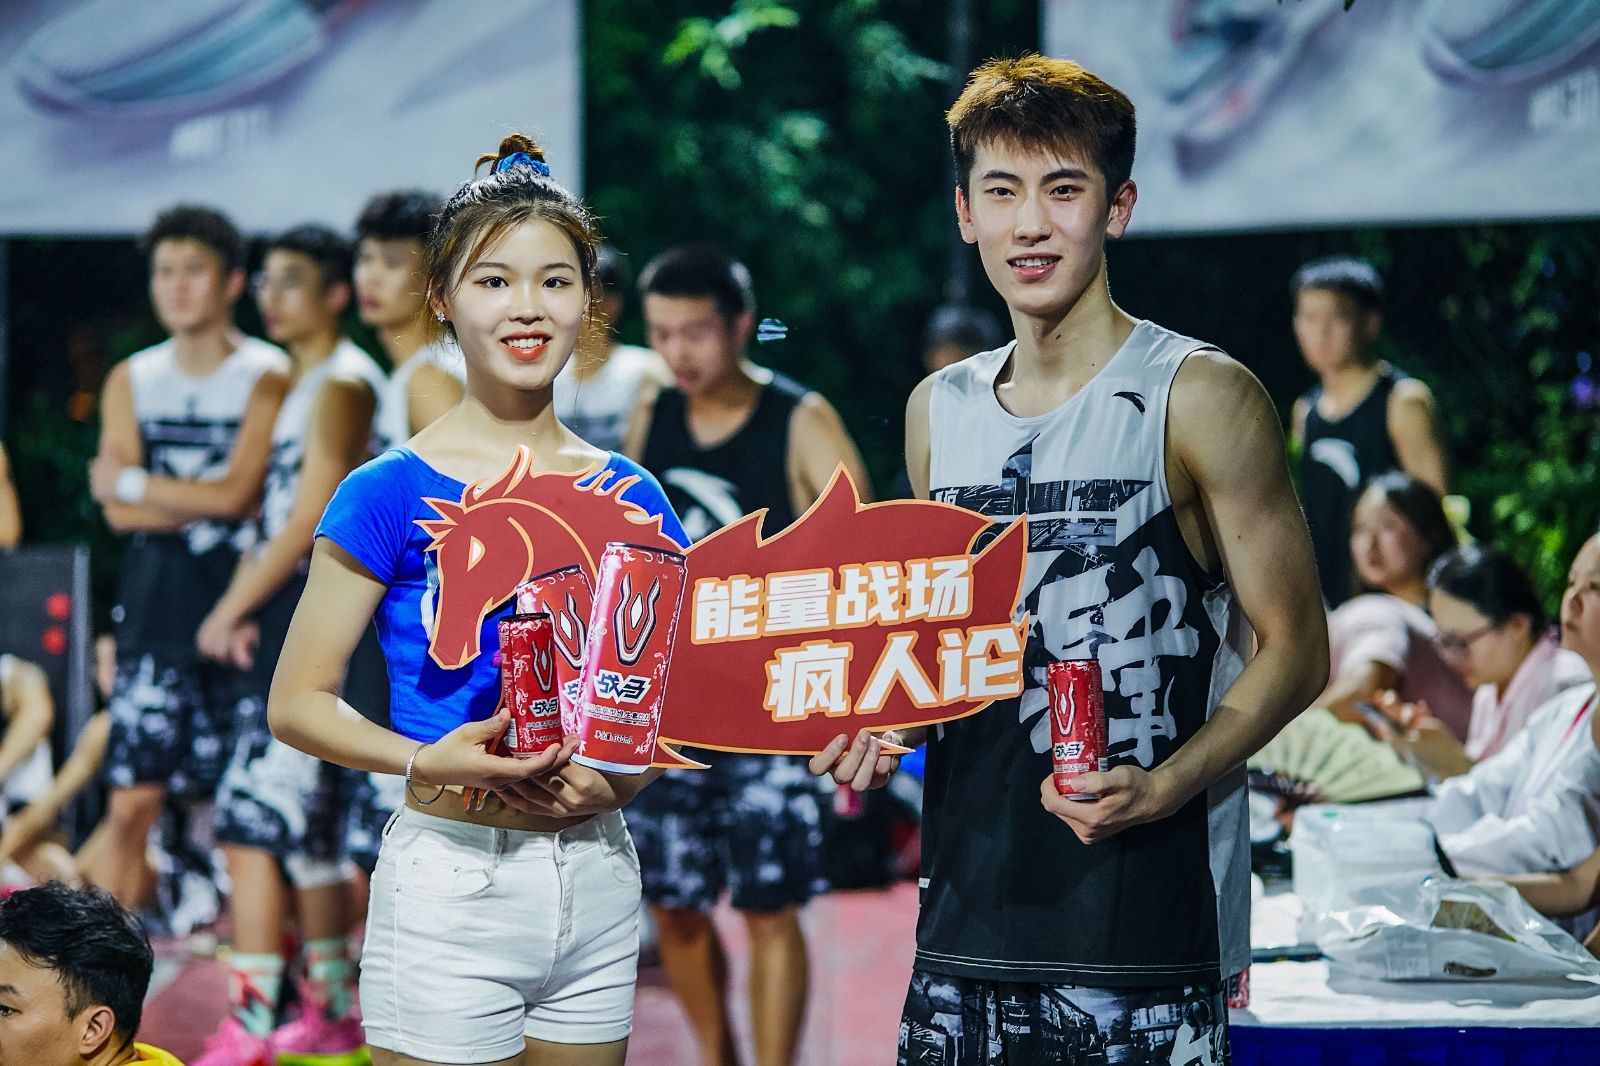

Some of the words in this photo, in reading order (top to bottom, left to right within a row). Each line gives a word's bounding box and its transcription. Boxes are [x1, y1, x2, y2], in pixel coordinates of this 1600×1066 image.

[694, 558, 971, 641] 能量战场
[595, 671, 649, 702] 战马
[764, 626, 1021, 718] 疯人论
